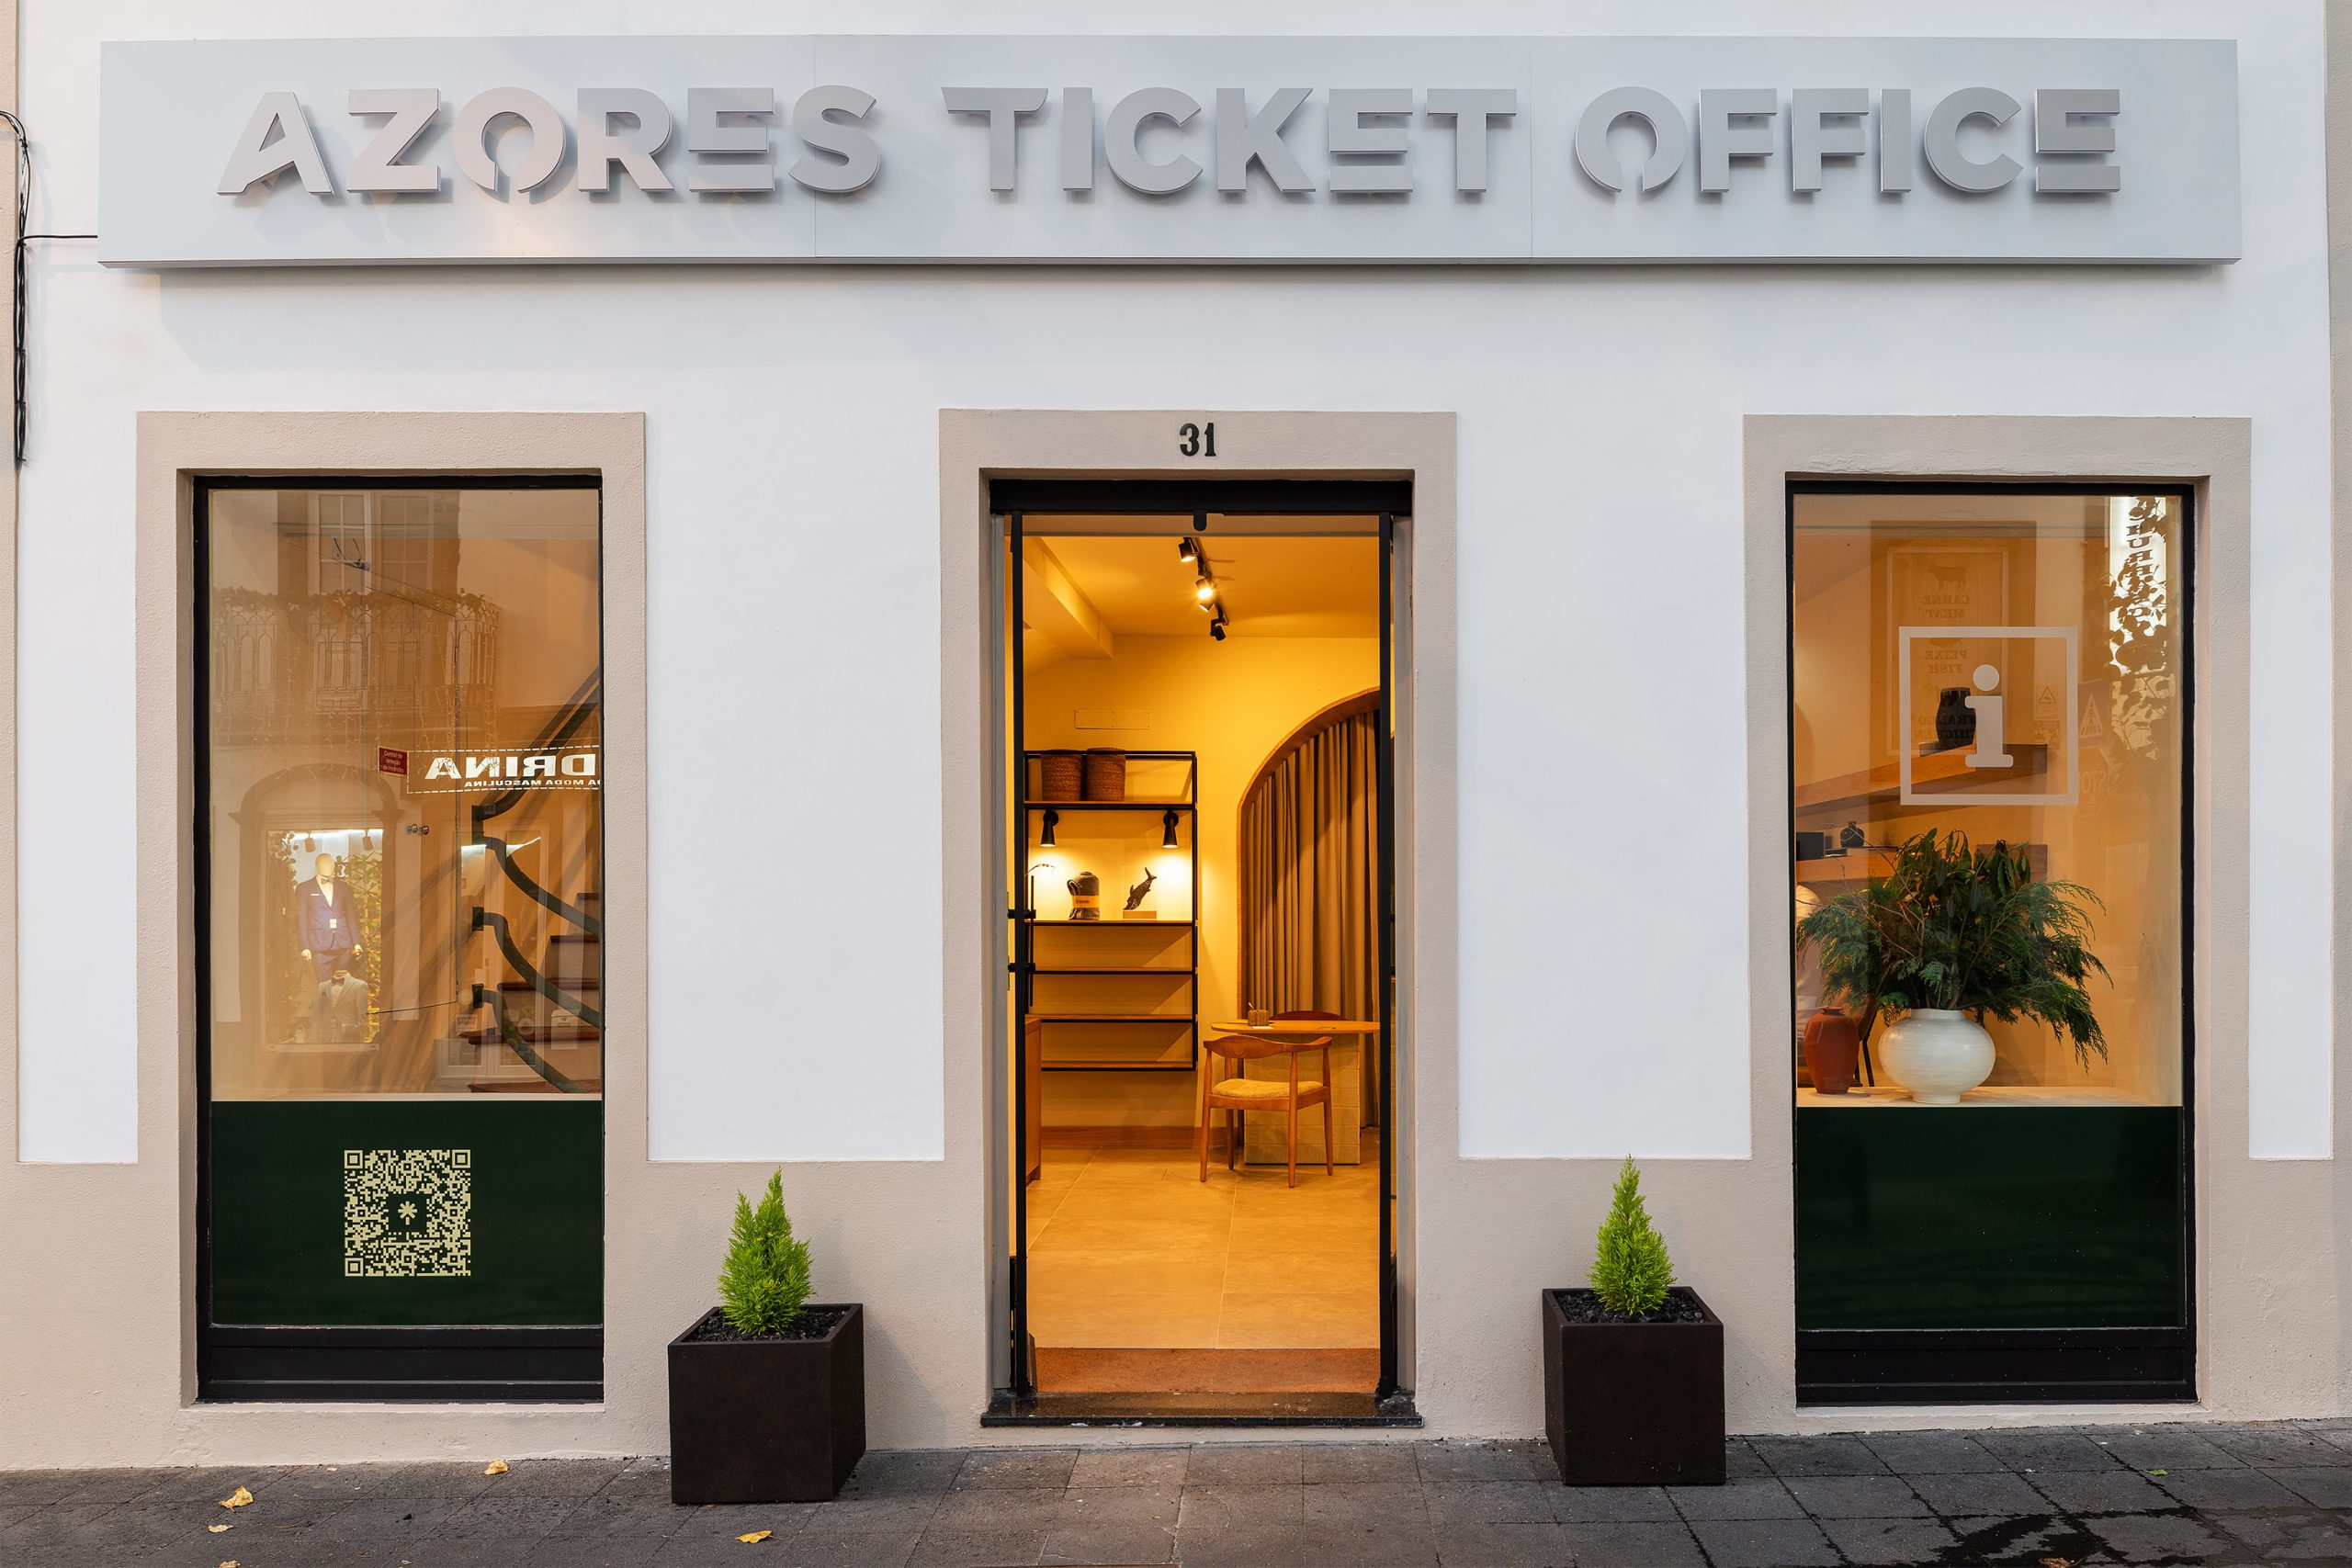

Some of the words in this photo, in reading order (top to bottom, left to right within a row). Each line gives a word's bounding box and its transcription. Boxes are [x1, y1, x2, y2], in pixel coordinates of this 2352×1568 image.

[217, 85, 880, 195] AZORES
[941, 86, 1517, 193] TICKET
[1576, 85, 2120, 194] OFFICE
[1180, 423, 1216, 457] 31
